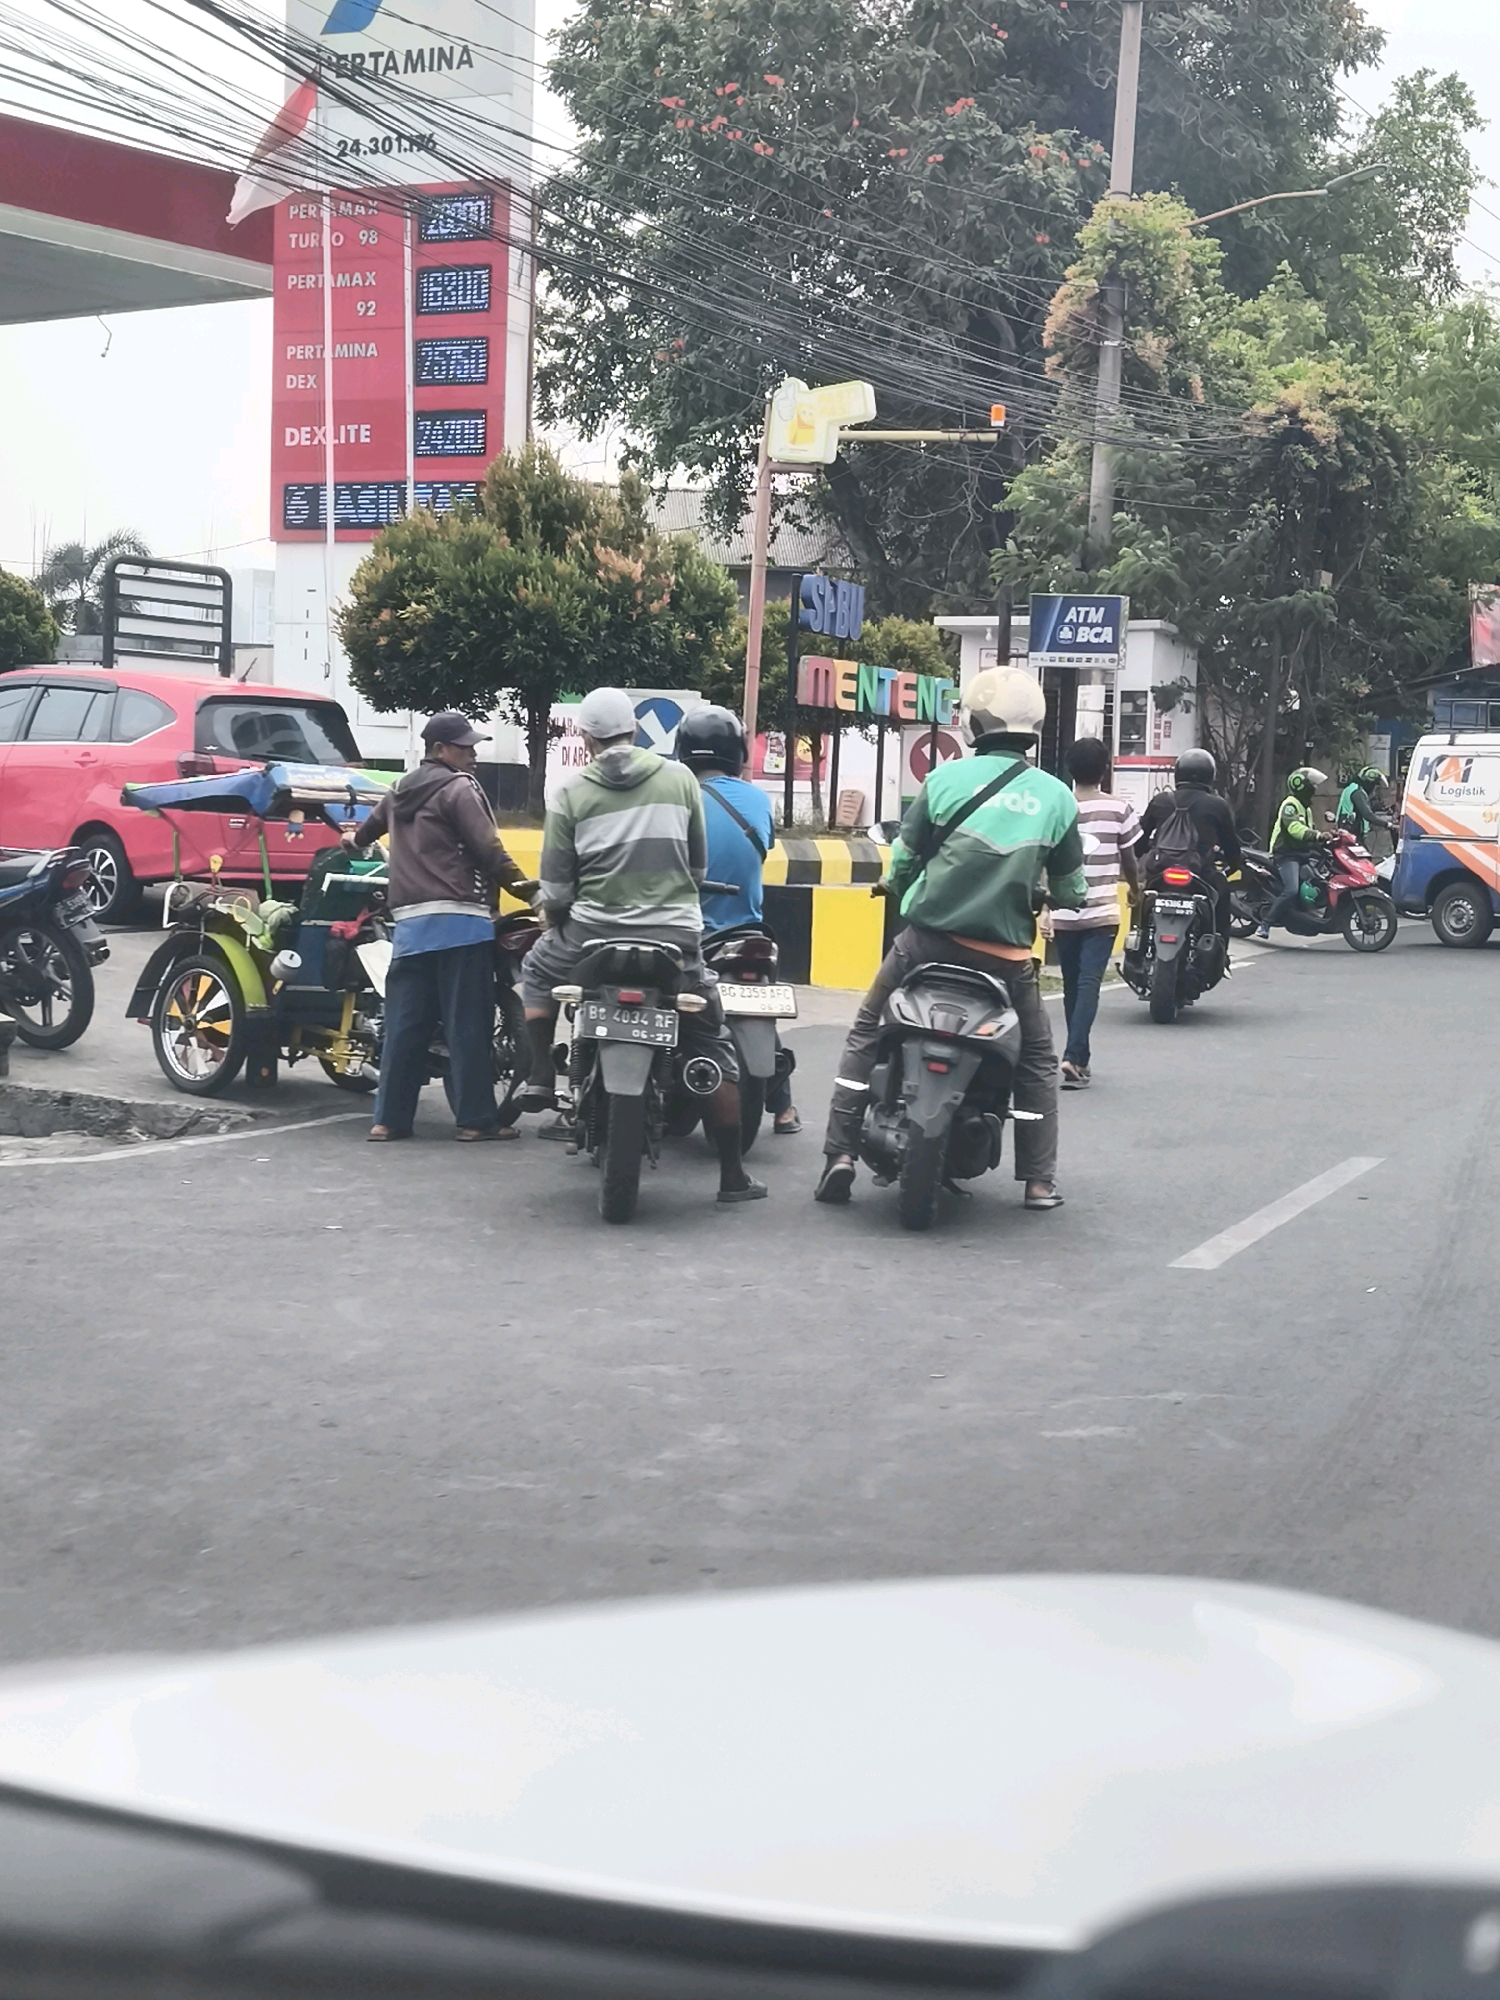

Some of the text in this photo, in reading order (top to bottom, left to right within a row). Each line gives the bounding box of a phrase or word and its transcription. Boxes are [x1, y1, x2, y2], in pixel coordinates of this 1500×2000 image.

[320, 44, 474, 79] ERTAMINA
[289, 200, 379, 219] PERMAX
[288, 229, 379, 249] TURO 98
[356, 300, 376, 316] 92
[286, 374, 317, 389] DEX
[284, 424, 371, 446] DEXITE
[799, 573, 865, 641] SPBU
[1063, 606, 1106, 624] ATM
[1075, 626, 1114, 644] BCA
[797, 655, 954, 725] MENTENG
[572, 745, 593, 768] ARE
[1417, 755, 1475, 783] KAI
[1440, 785, 1486, 798] Logistik
